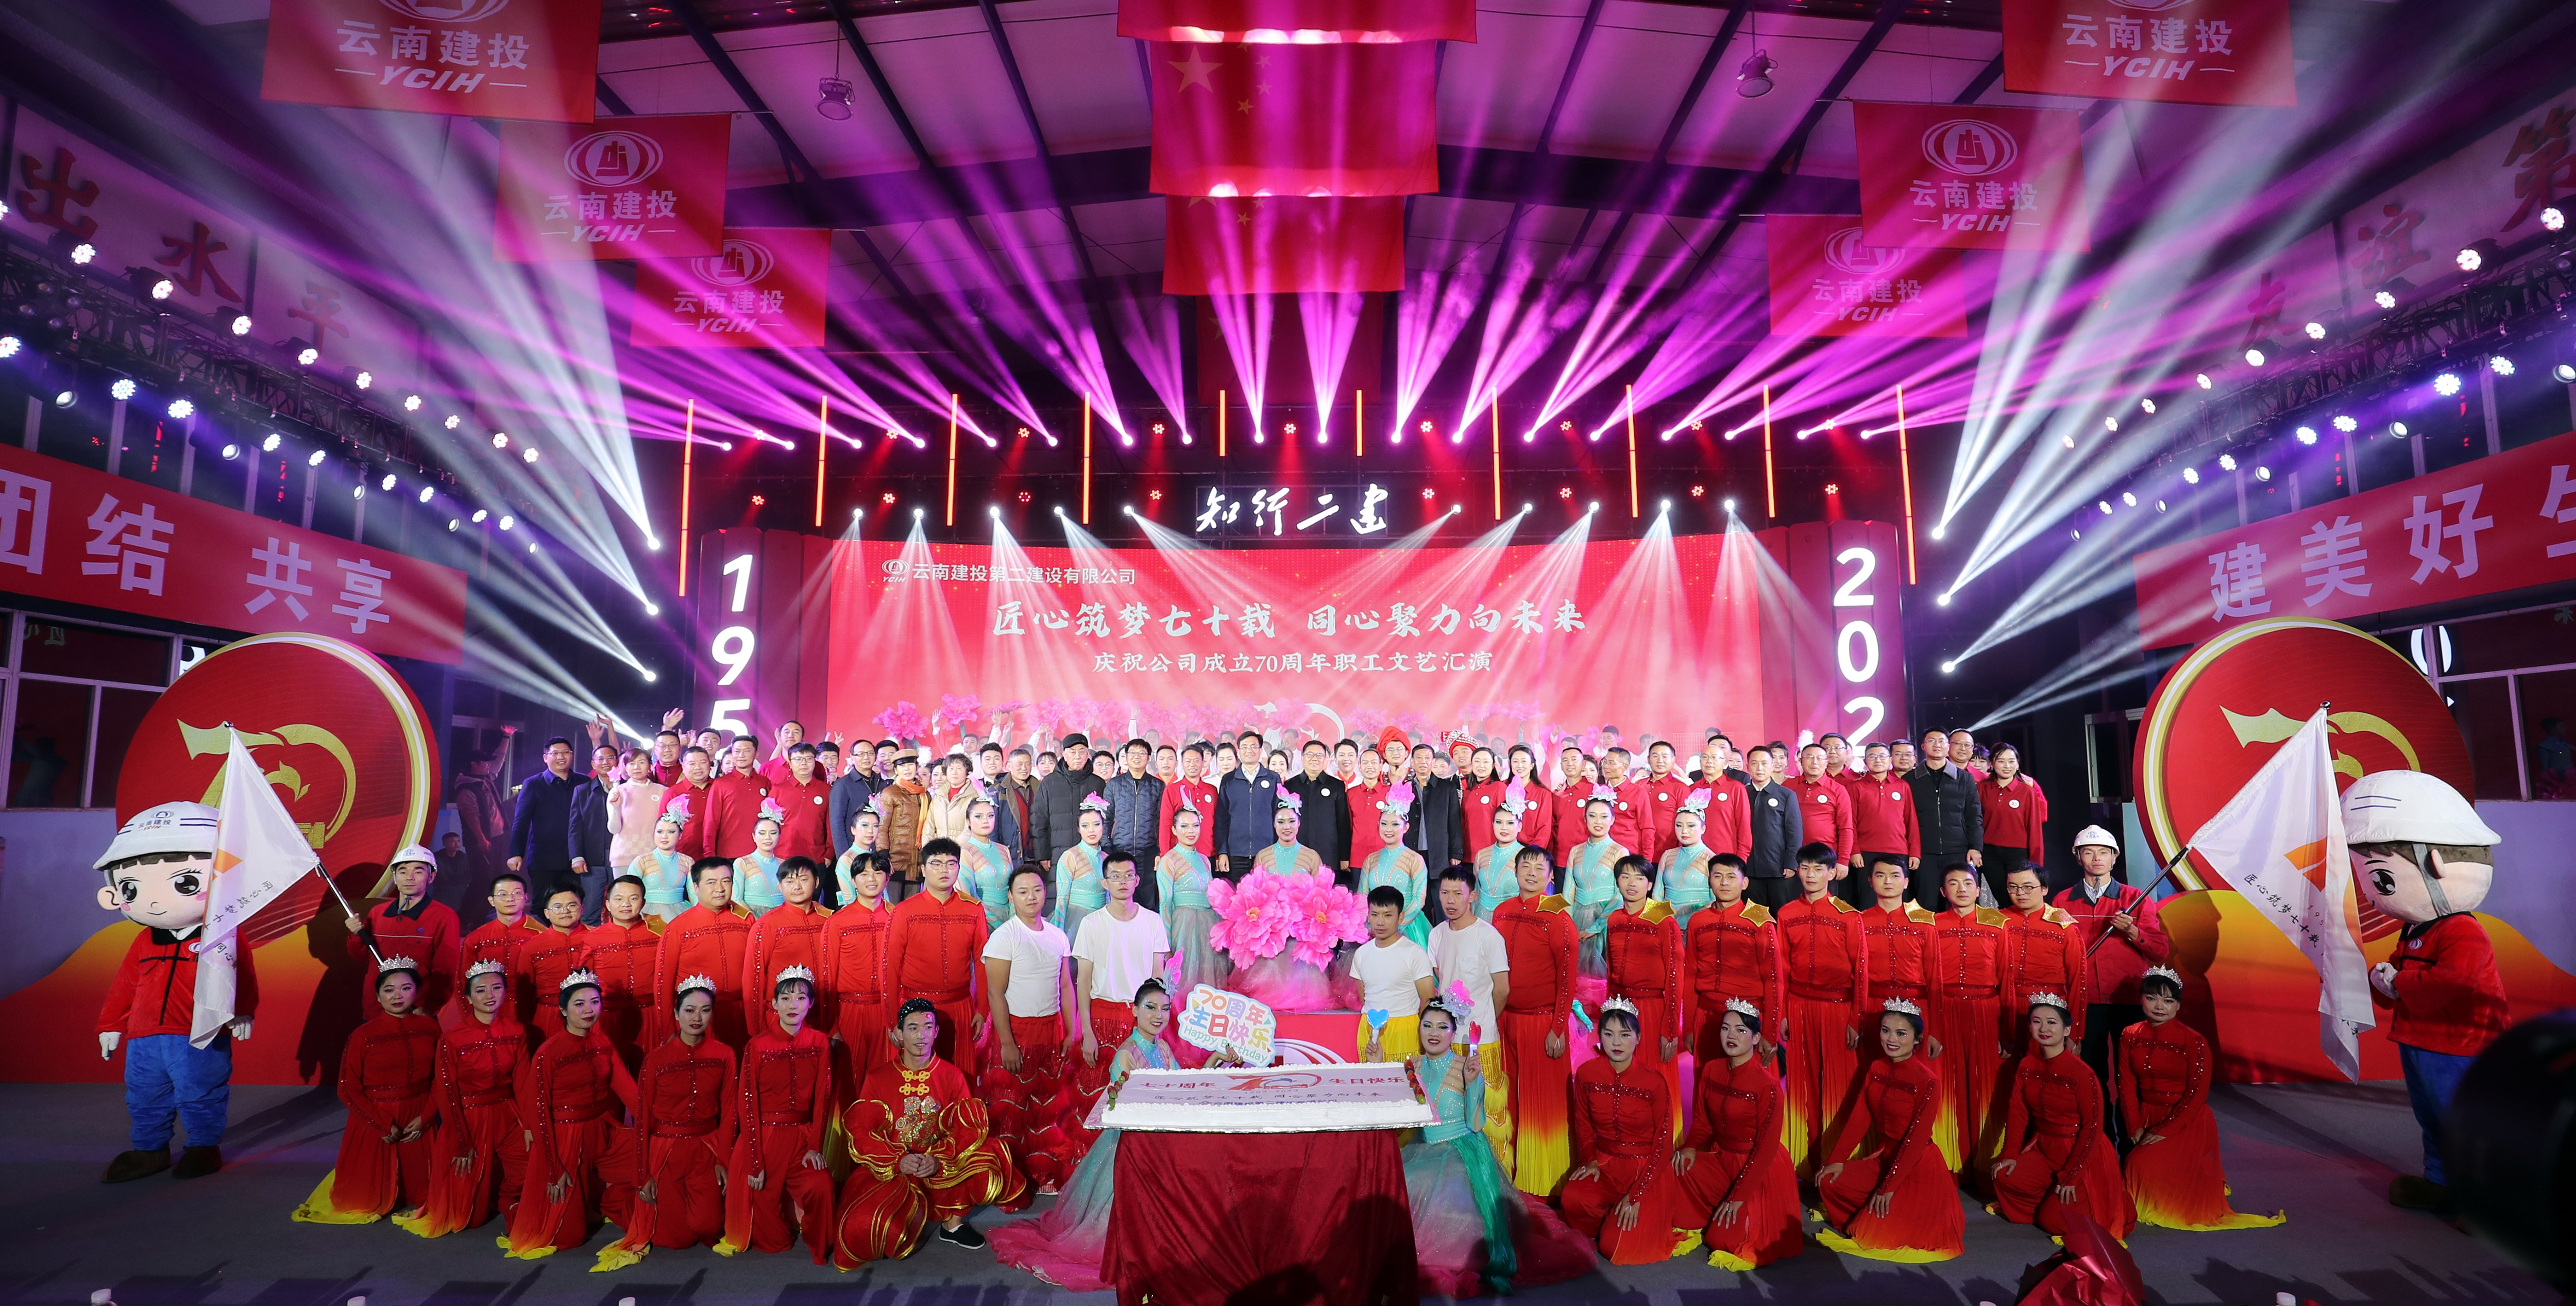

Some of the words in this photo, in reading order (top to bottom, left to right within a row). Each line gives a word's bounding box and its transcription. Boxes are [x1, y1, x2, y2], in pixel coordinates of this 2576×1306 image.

[337, 20, 530, 70] 云南建投
[2062, 14, 2232, 56] 云南建投
[379, 65, 485, 93] YCIH
[2104, 56, 2195, 80] YCIH
[544, 190, 677, 221] 云南建投
[1910, 179, 2039, 211] 云南建投
[571, 224, 645, 242] YCIH
[1941, 213, 2011, 232] YCIH
[673, 290, 785, 314] 云南建投
[1812, 278, 1923, 303] 云南建投
[697, 317, 758, 332] YCIH
[1838, 307, 1899, 322] YCIH
[1196, 482, 1389, 536] 知行二建
[244, 537, 392, 634] 共享
[912, 563, 1136, 585] 云南建投第二建设有限公司
[993, 600, 1277, 639] 匠心筑梦七十载
[1306, 598, 1586, 638] 同心聚力向未来
[1092, 650, 1493, 675] 庆祝公司成立70周年职工文艺汇演
[1199, 989, 1266, 1026] 70周年
[1183, 1025, 1218, 1046] Happy
[1189, 1006, 1270, 1050] 生日快乐
[1328, 1076, 1405, 1084] 生日快乐
